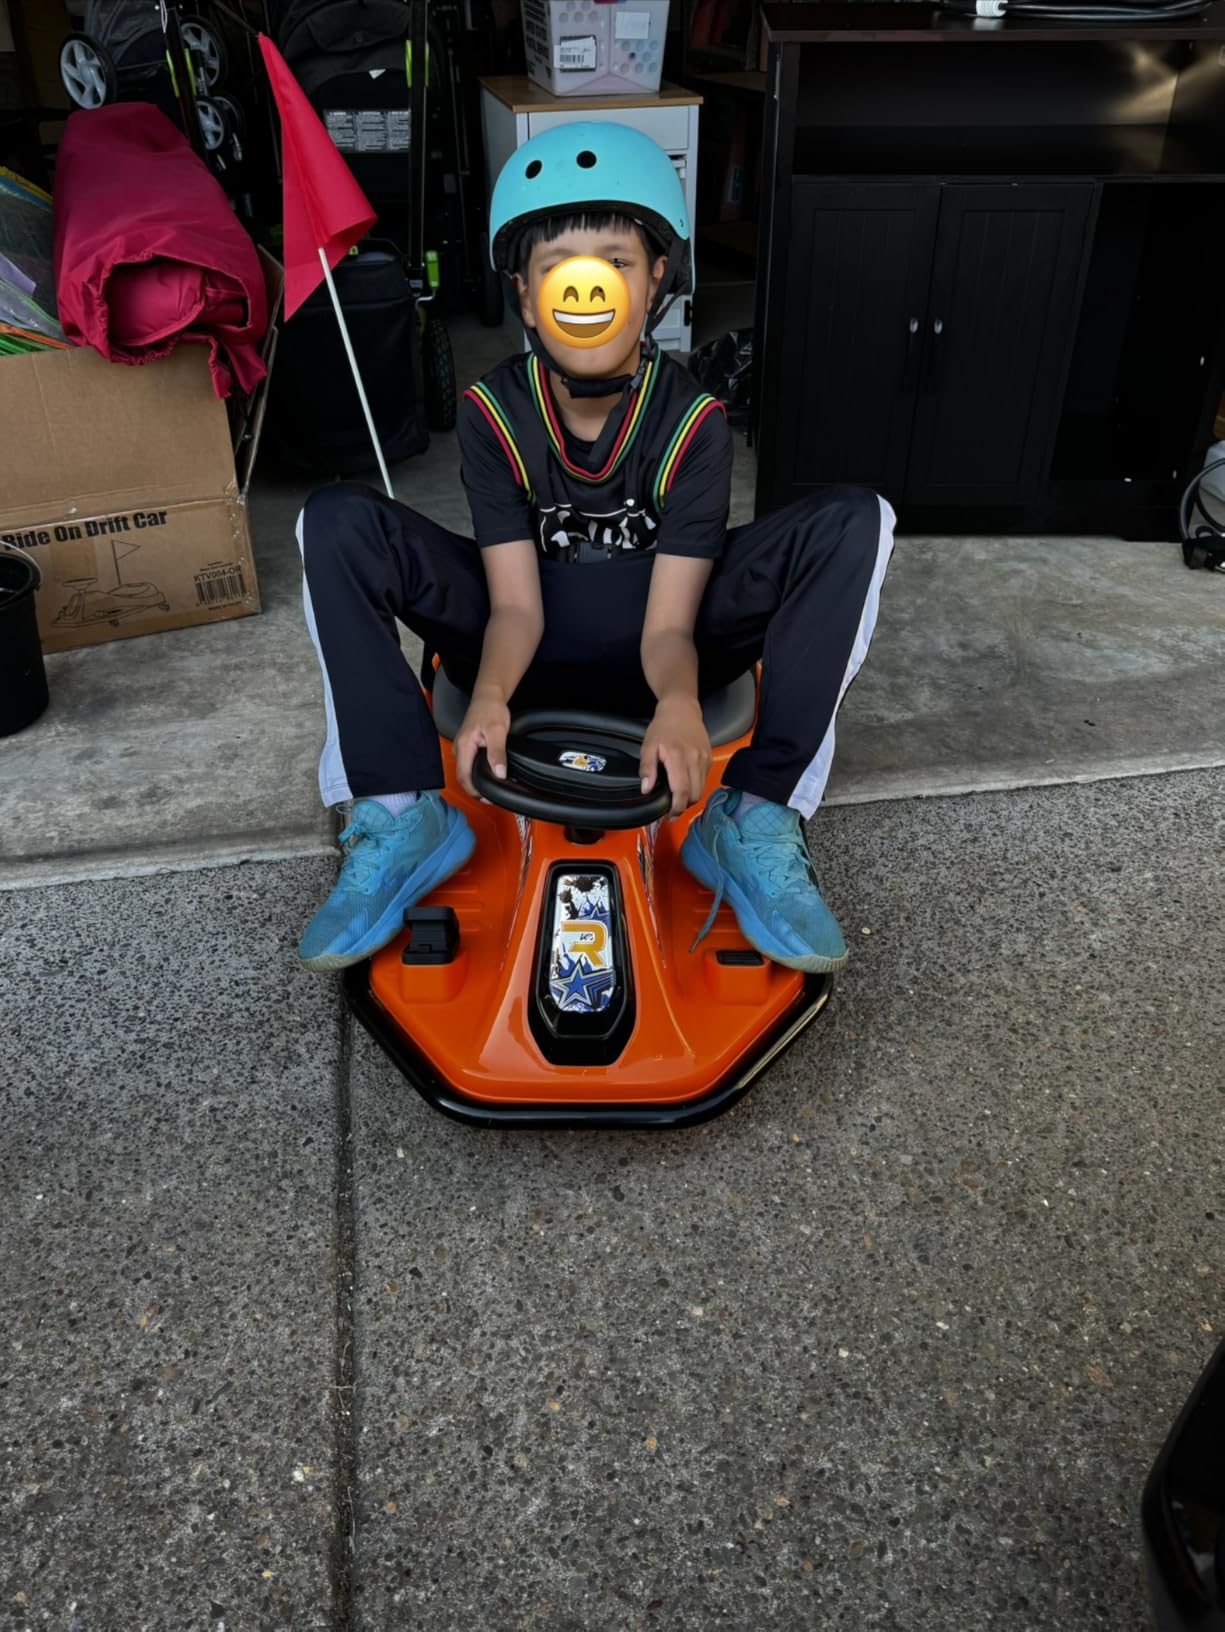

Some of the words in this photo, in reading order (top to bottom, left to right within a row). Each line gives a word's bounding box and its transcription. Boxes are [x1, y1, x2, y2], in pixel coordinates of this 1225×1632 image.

[2, 531, 51, 550] Ride
[54, 526, 82, 542] On
[84, 515, 131, 538] Drift
[133, 510, 168, 528] Car
